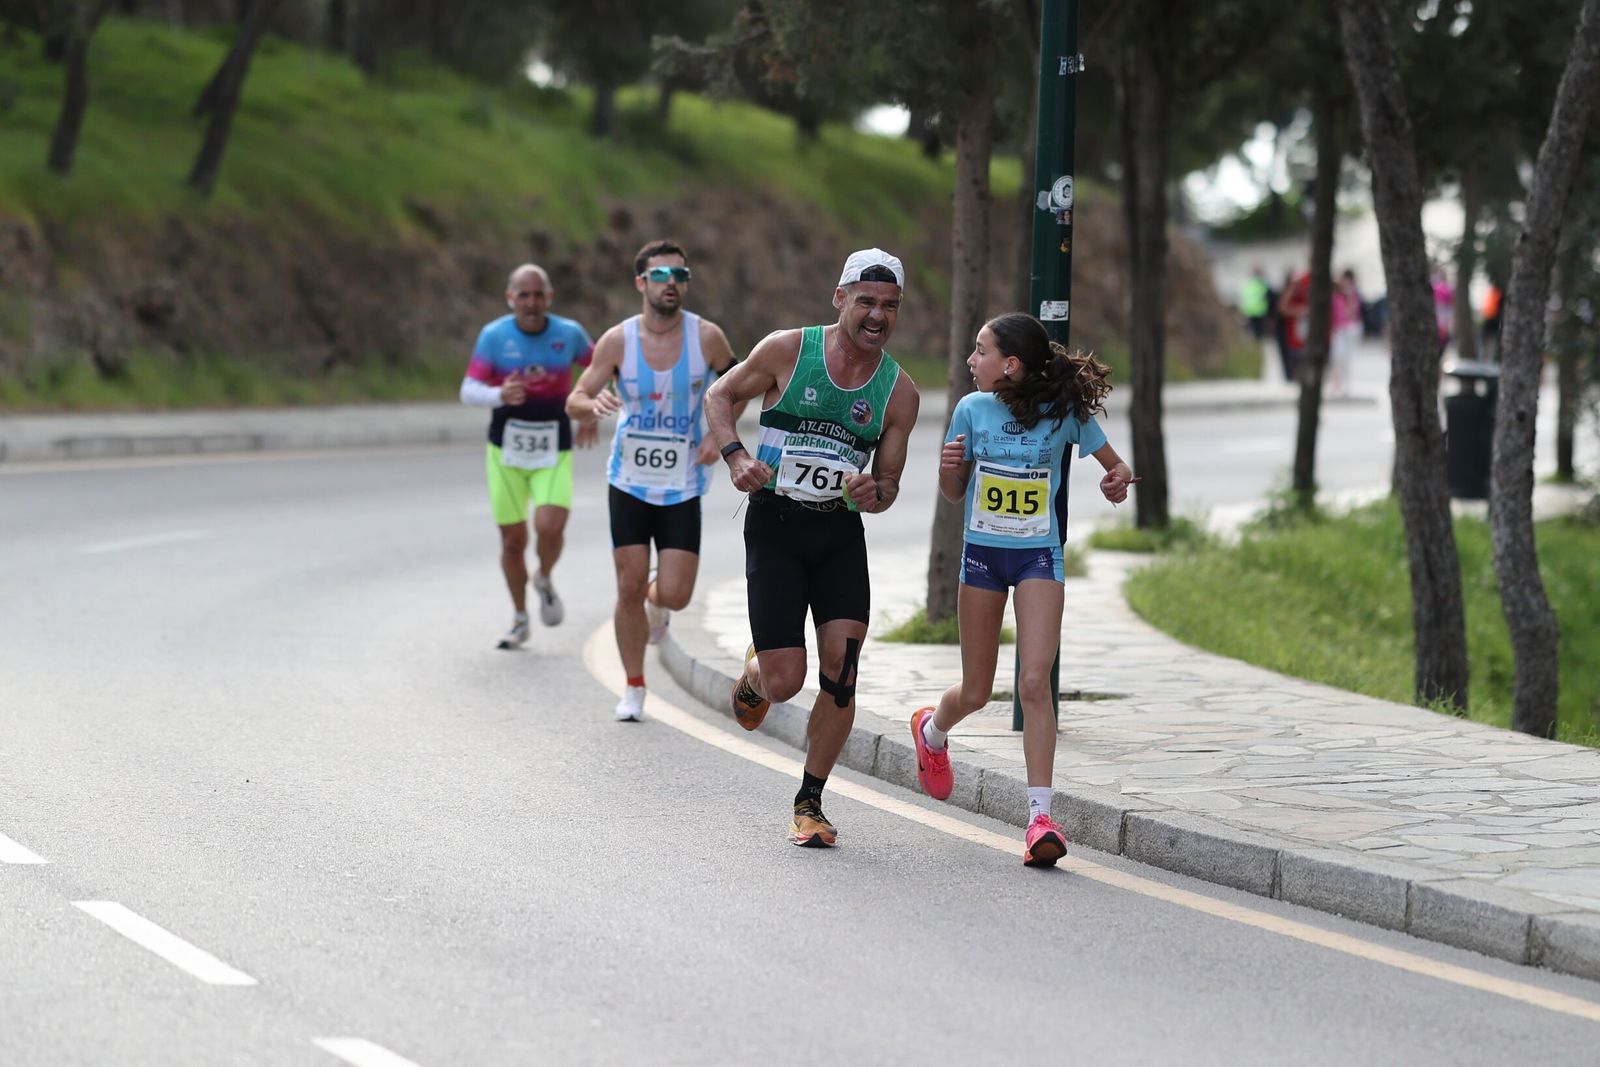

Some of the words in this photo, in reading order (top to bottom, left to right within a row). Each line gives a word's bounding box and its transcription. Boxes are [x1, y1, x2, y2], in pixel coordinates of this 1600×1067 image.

[626, 409, 695, 435] málag
[797, 420, 857, 446] ATLETISMO
[513, 434, 549, 453] 534
[634, 447, 678, 469] 669
[794, 462, 845, 491] 761
[986, 486, 1039, 515] 915
